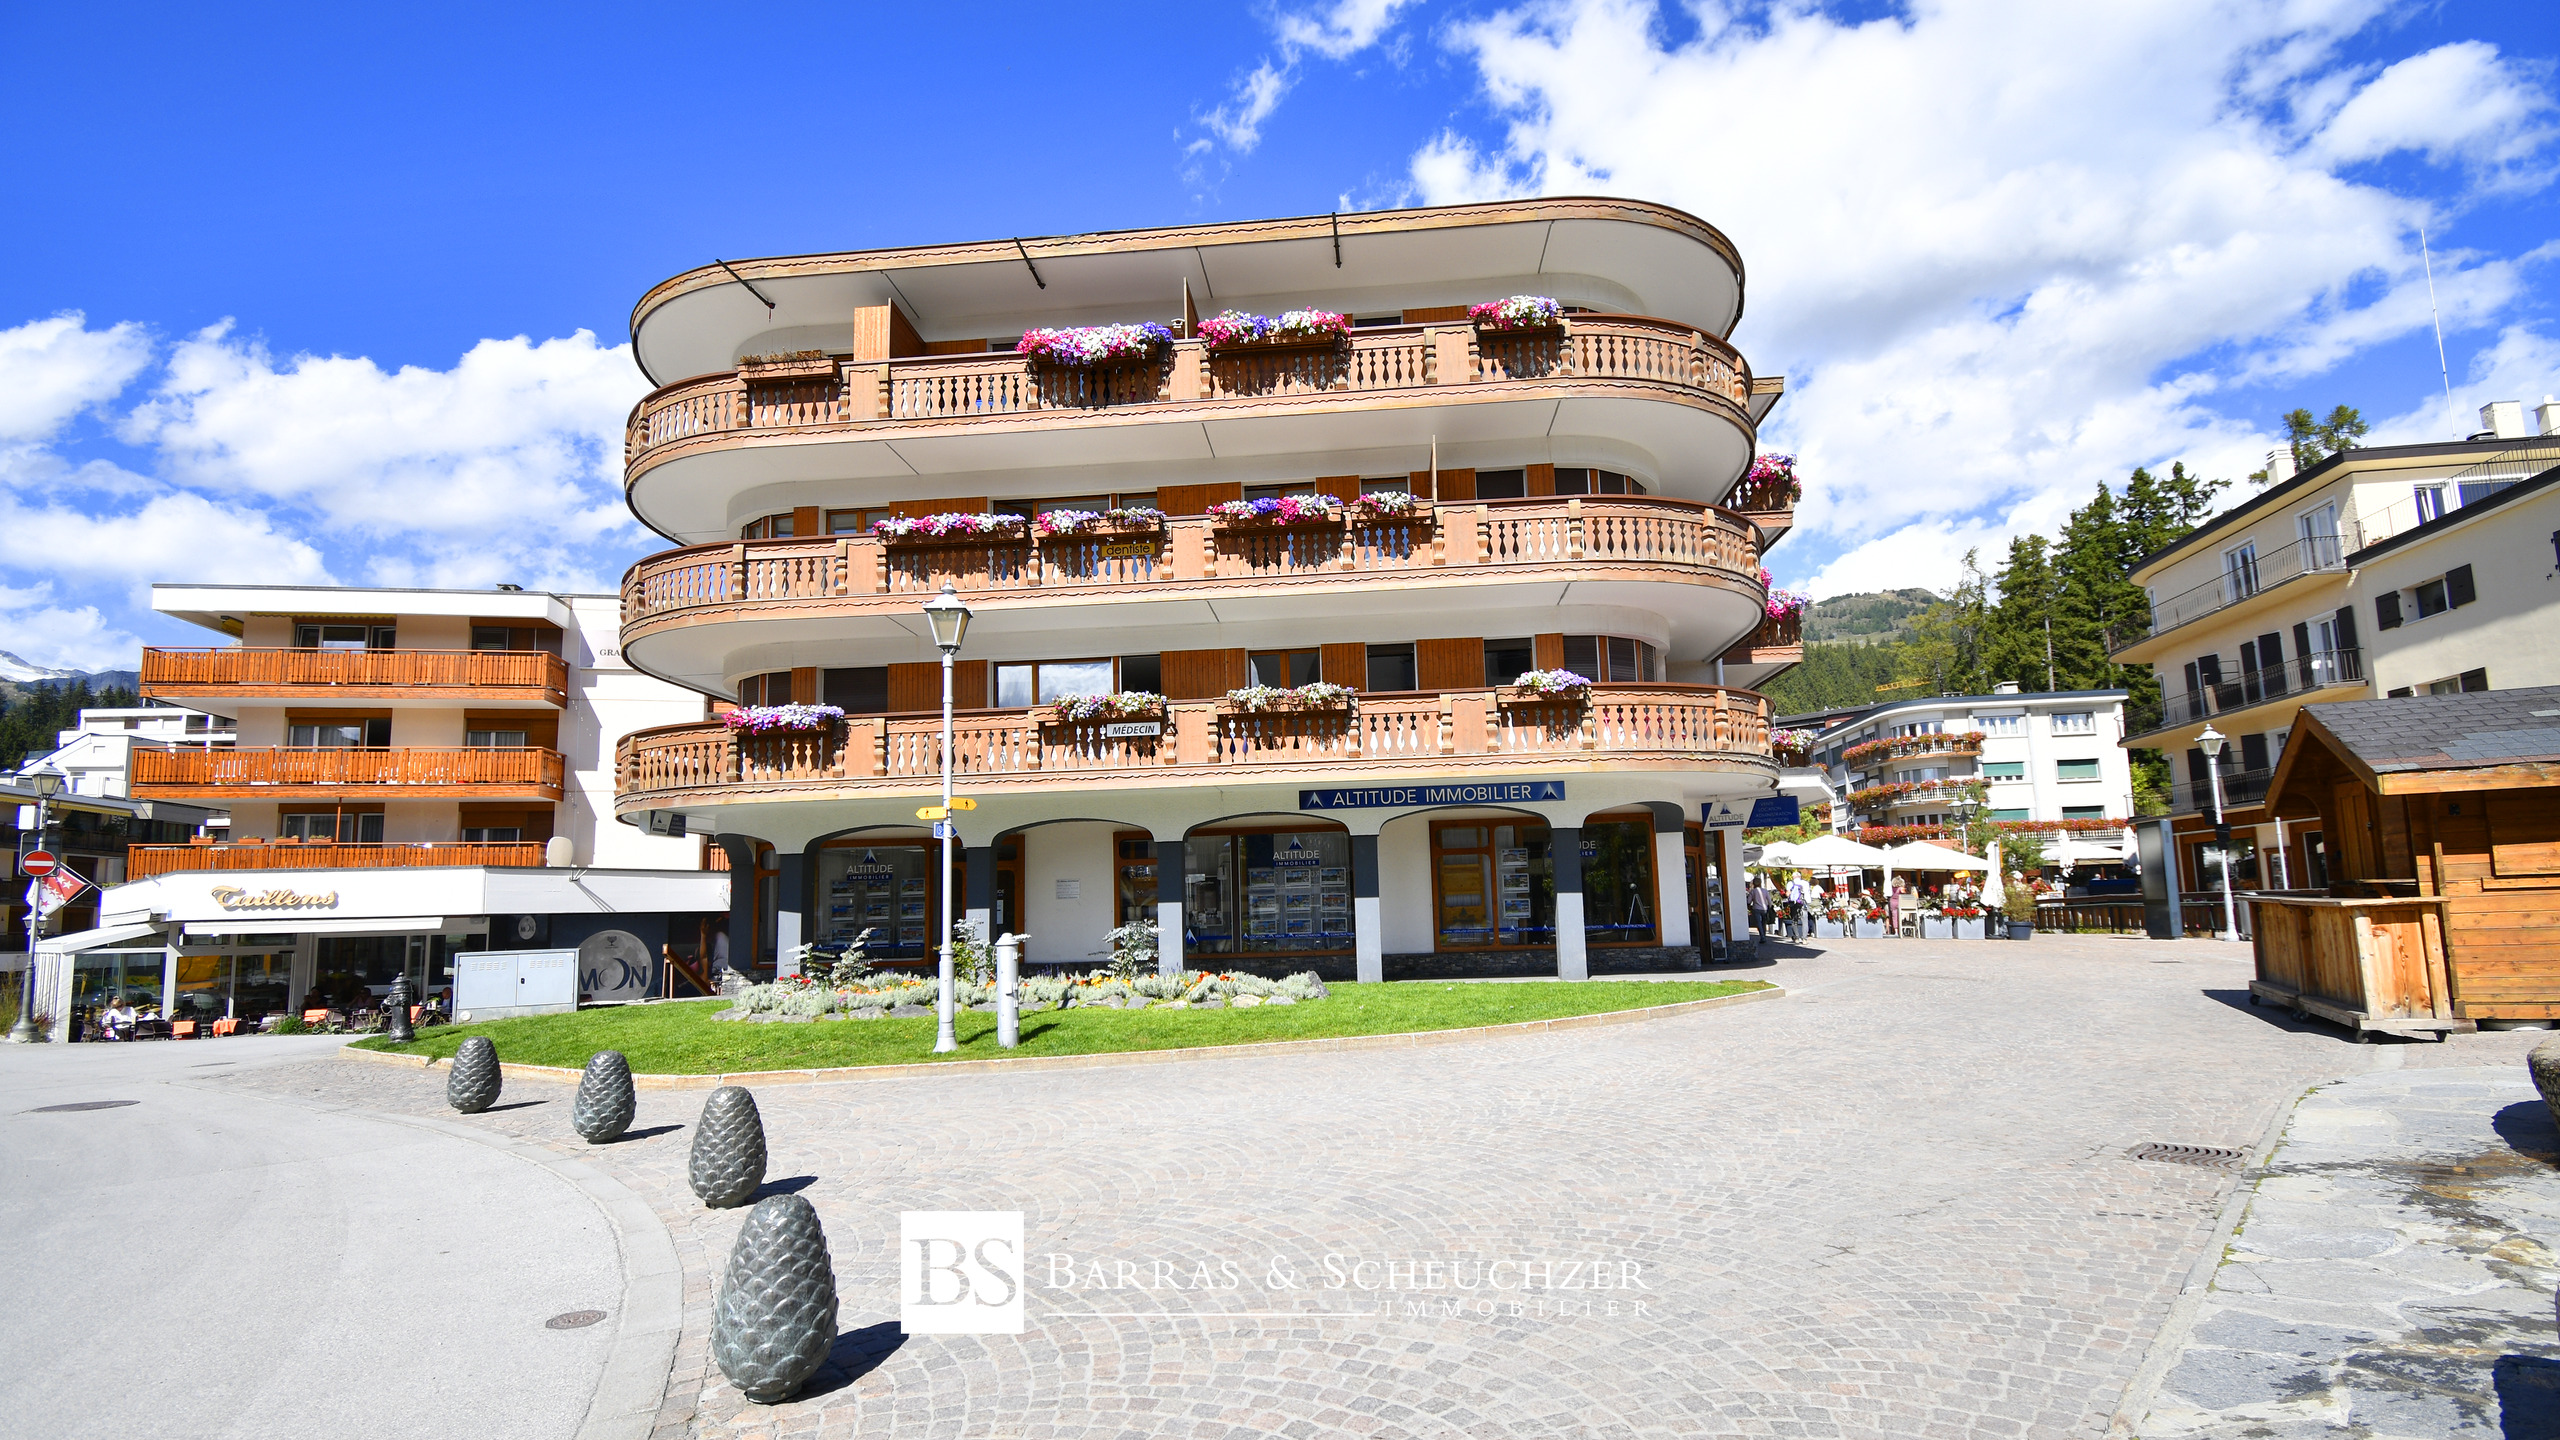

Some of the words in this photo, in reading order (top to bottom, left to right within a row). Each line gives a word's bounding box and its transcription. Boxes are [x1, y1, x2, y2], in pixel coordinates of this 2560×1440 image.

[1106, 545, 1150, 555] dentiste
[1112, 725, 1155, 735] MÉDECIN
[1332, 789, 1417, 806] ALTITUDE
[1425, 785, 1532, 802] IMMOBILIER
[1709, 813, 1744, 822] ALTITUDE
[1273, 850, 1319, 860] ALTITUDE
[846, 864, 893, 874] ALTITUDE
[210, 885, 336, 907] Taillens
